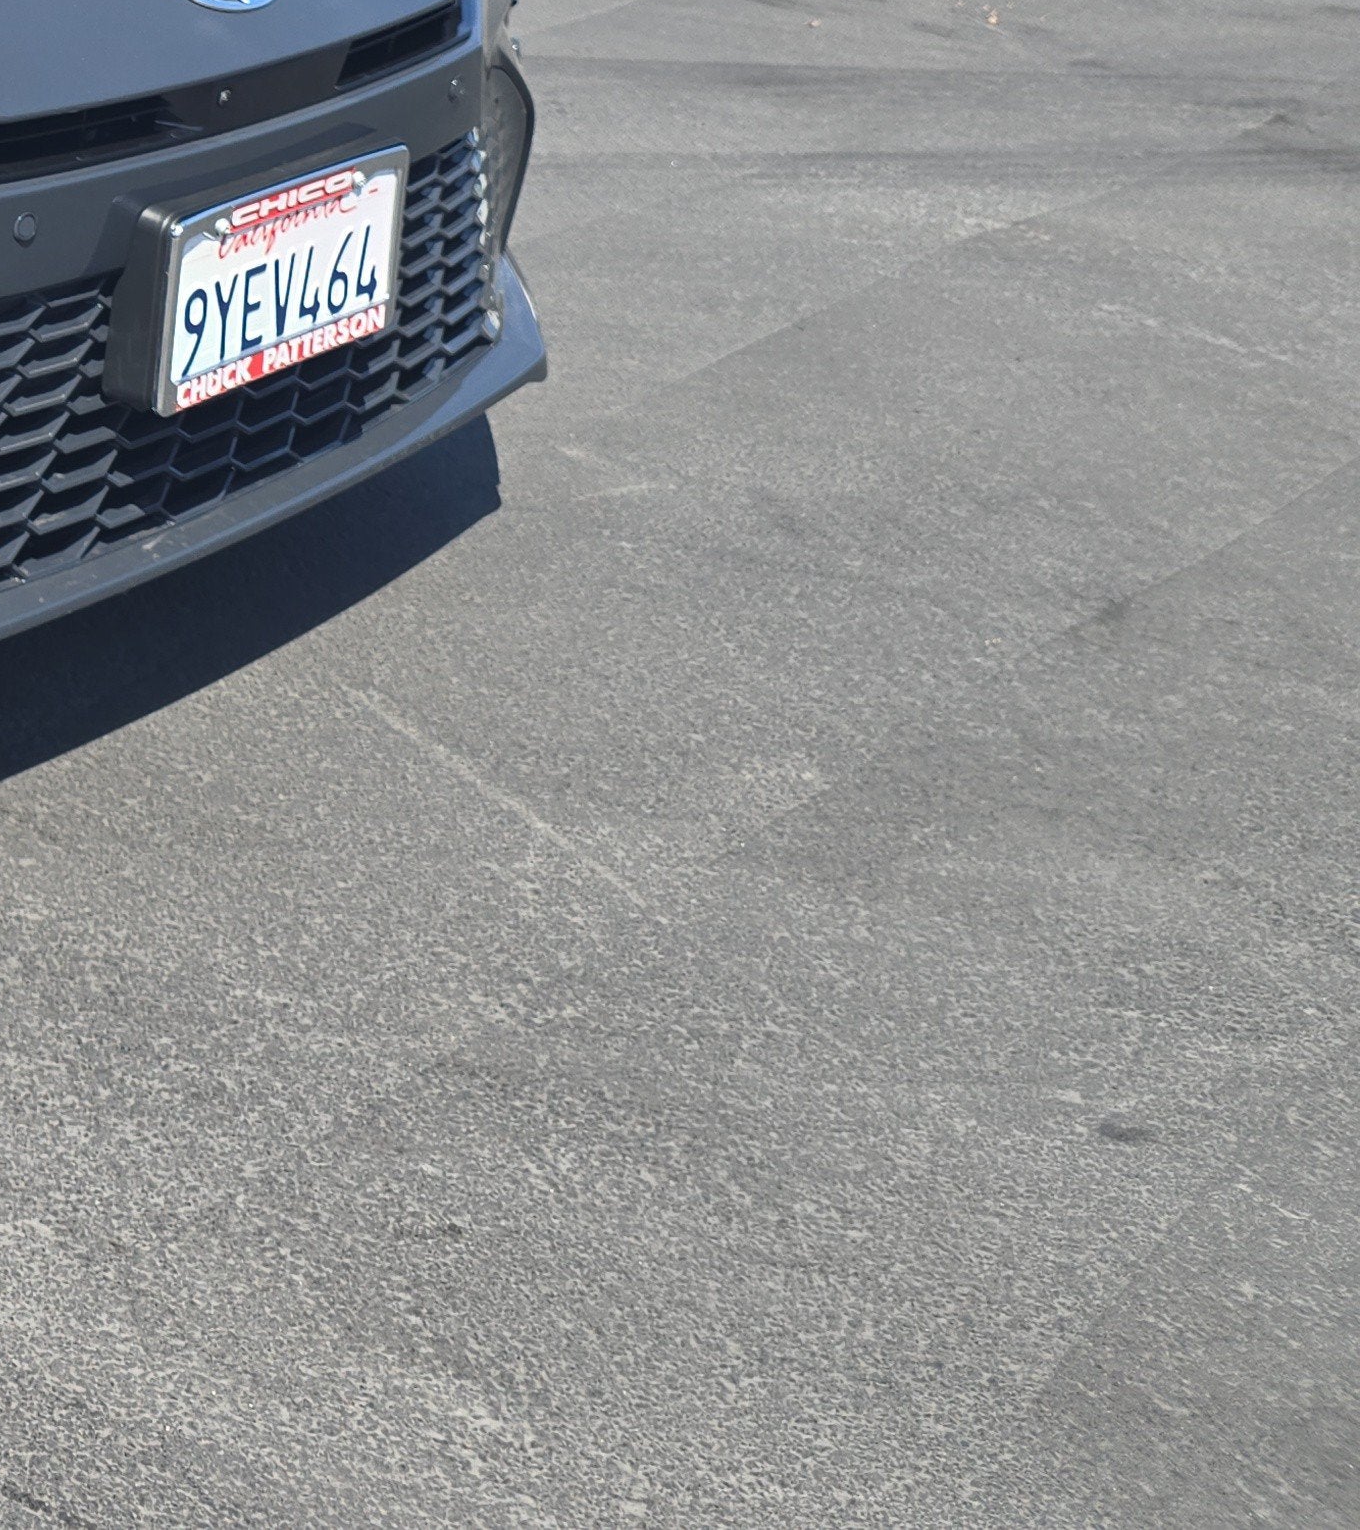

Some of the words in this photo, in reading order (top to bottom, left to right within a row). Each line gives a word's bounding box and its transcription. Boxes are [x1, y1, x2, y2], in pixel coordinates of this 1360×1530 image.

[231, 170, 353, 227] CHICO
[182, 223, 378, 376] 9YEV464
[176, 355, 253, 409] CHUCK
[262, 304, 386, 374] PATTERSON
